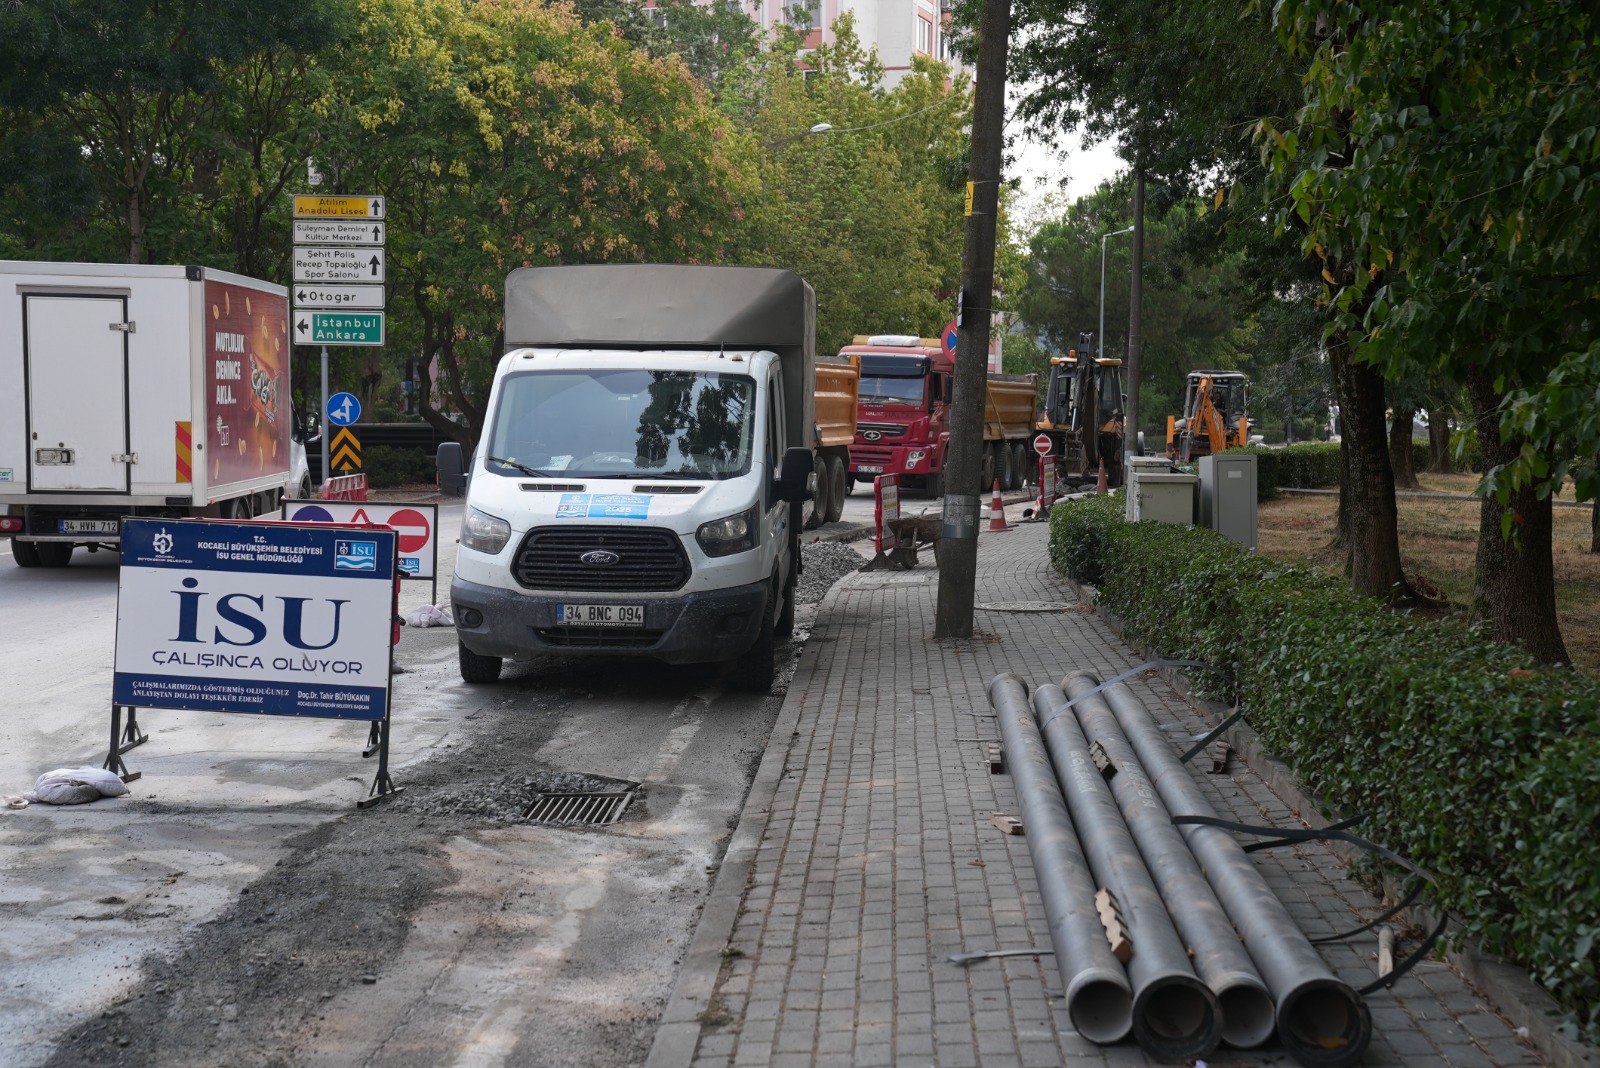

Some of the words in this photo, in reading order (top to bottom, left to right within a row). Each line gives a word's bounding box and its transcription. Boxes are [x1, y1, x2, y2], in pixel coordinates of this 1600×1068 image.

[319, 198, 348, 206] Atılım
[298, 206, 337, 214] Anadolu
[296, 224, 336, 232] Süleyman
[308, 250, 330, 258] Şehit
[296, 260, 322, 268] Recep
[325, 260, 366, 270] Topaloğlu
[305, 270, 325, 279] Spor
[310, 291, 356, 304] Otogar
[316, 314, 376, 328] İstanbul
[316, 329, 366, 340] Ankara
[216, 332, 244, 353] MUTLULUK
[216, 354, 240, 380] DENİNCE
[64, 522, 74, 532] 34
[80, 522, 96, 532] HVH
[101, 522, 117, 532] 712
[198, 542, 229, 550] KOCAELİ
[231, 543, 278, 554] BÜYÜKŞEHİR
[280, 545, 322, 555] BELEDİYESİ
[352, 544, 374, 556] İSU
[217, 550, 229, 559] İSU
[231, 552, 255, 561] GENEL
[257, 554, 303, 564] MÜDÜRLÜĞÜ
[590, 554, 610, 562] Ford
[168, 577, 351, 650] İSU
[566, 606, 581, 620] 34
[589, 606, 612, 620] BNC
[619, 607, 641, 621] 094
[152, 650, 264, 669] ÇALIŞINCA
[273, 657, 363, 675] OLUYOR
[132, 681, 201, 691] ÇALIŞMALARIMIZDA
[204, 684, 244, 694] GÖSTERMİŞ
[246, 687, 289, 696] OLDUĞUNUZ
[133, 690, 172, 699] ANLAYIŞTAN
[174, 692, 199, 700] DOLAYI
[201, 693, 237, 702] TEŞEKKÜR
[238, 695, 263, 703] EDERİZ
[335, 692, 370, 702] BÜYÜKAKIN
